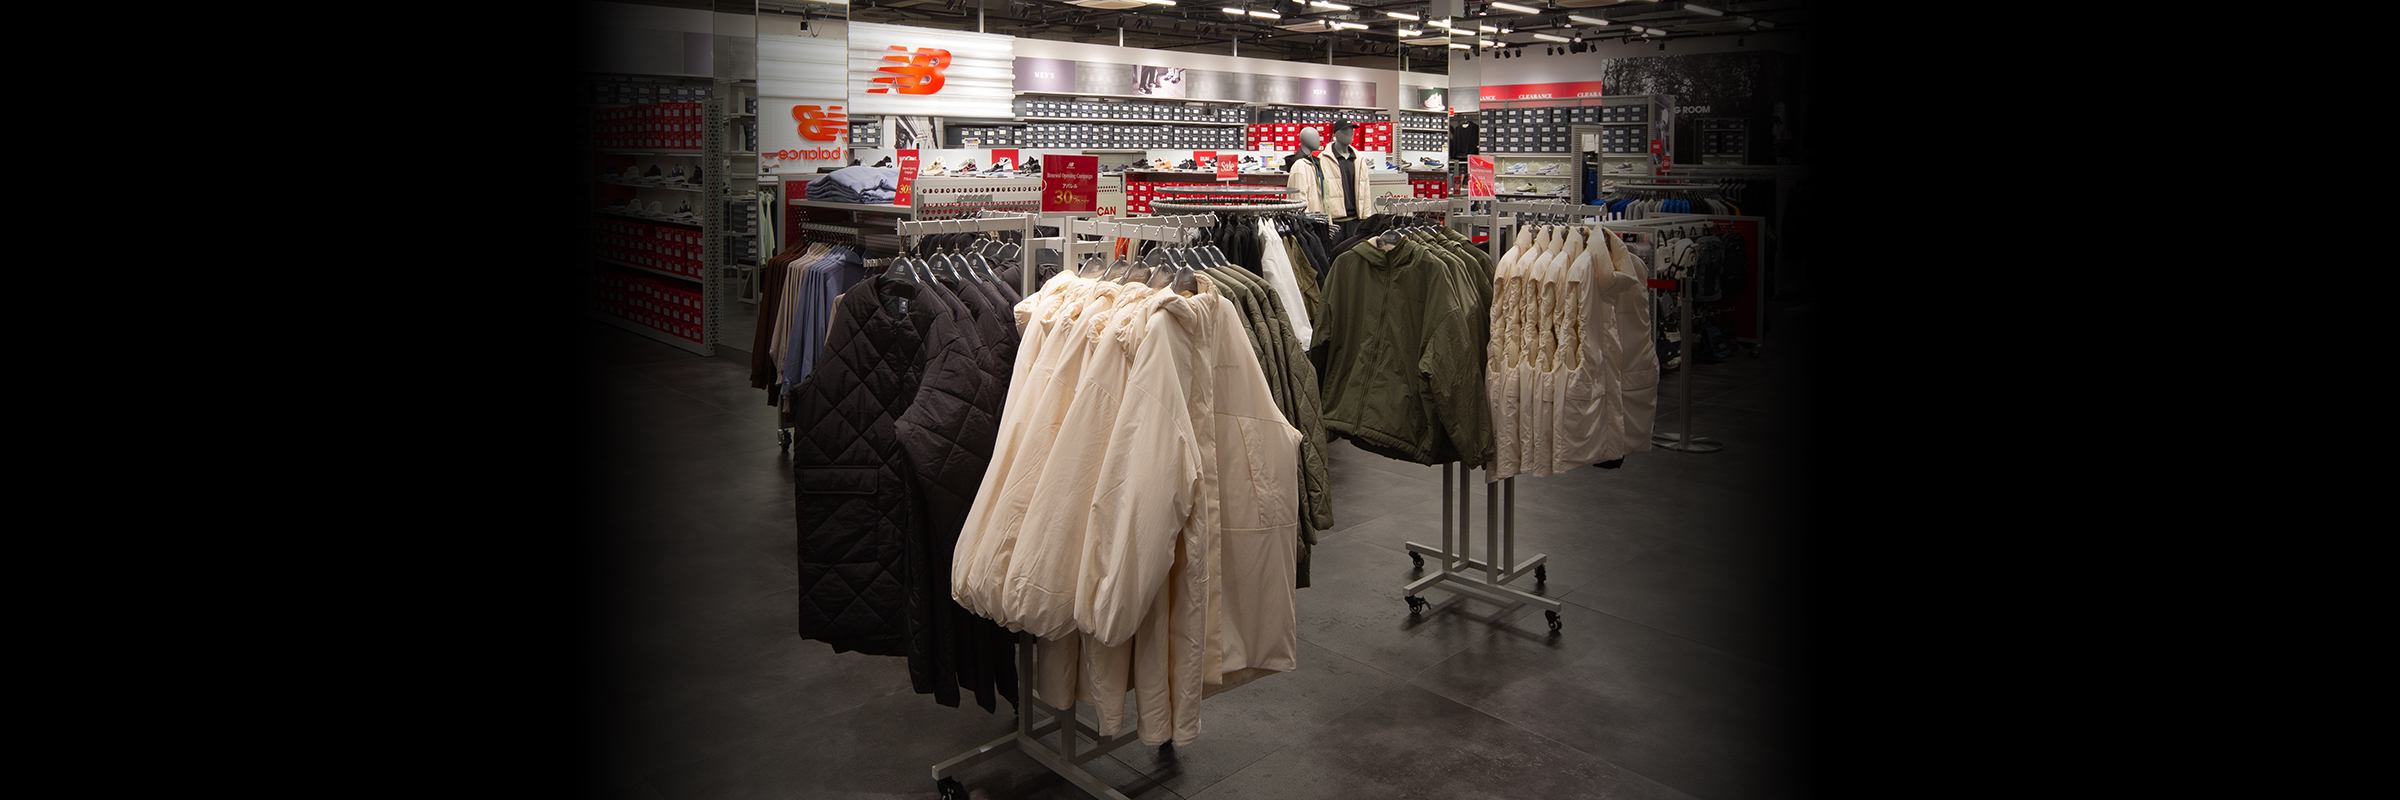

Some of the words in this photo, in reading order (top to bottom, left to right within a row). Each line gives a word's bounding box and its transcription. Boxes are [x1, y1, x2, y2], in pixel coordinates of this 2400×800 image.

[1034, 71, 1055, 79] MEN'S
[1682, 105, 1711, 114] ROOM
[1220, 161, 1235, 172] Sale
[1097, 206, 1116, 216] CAN
